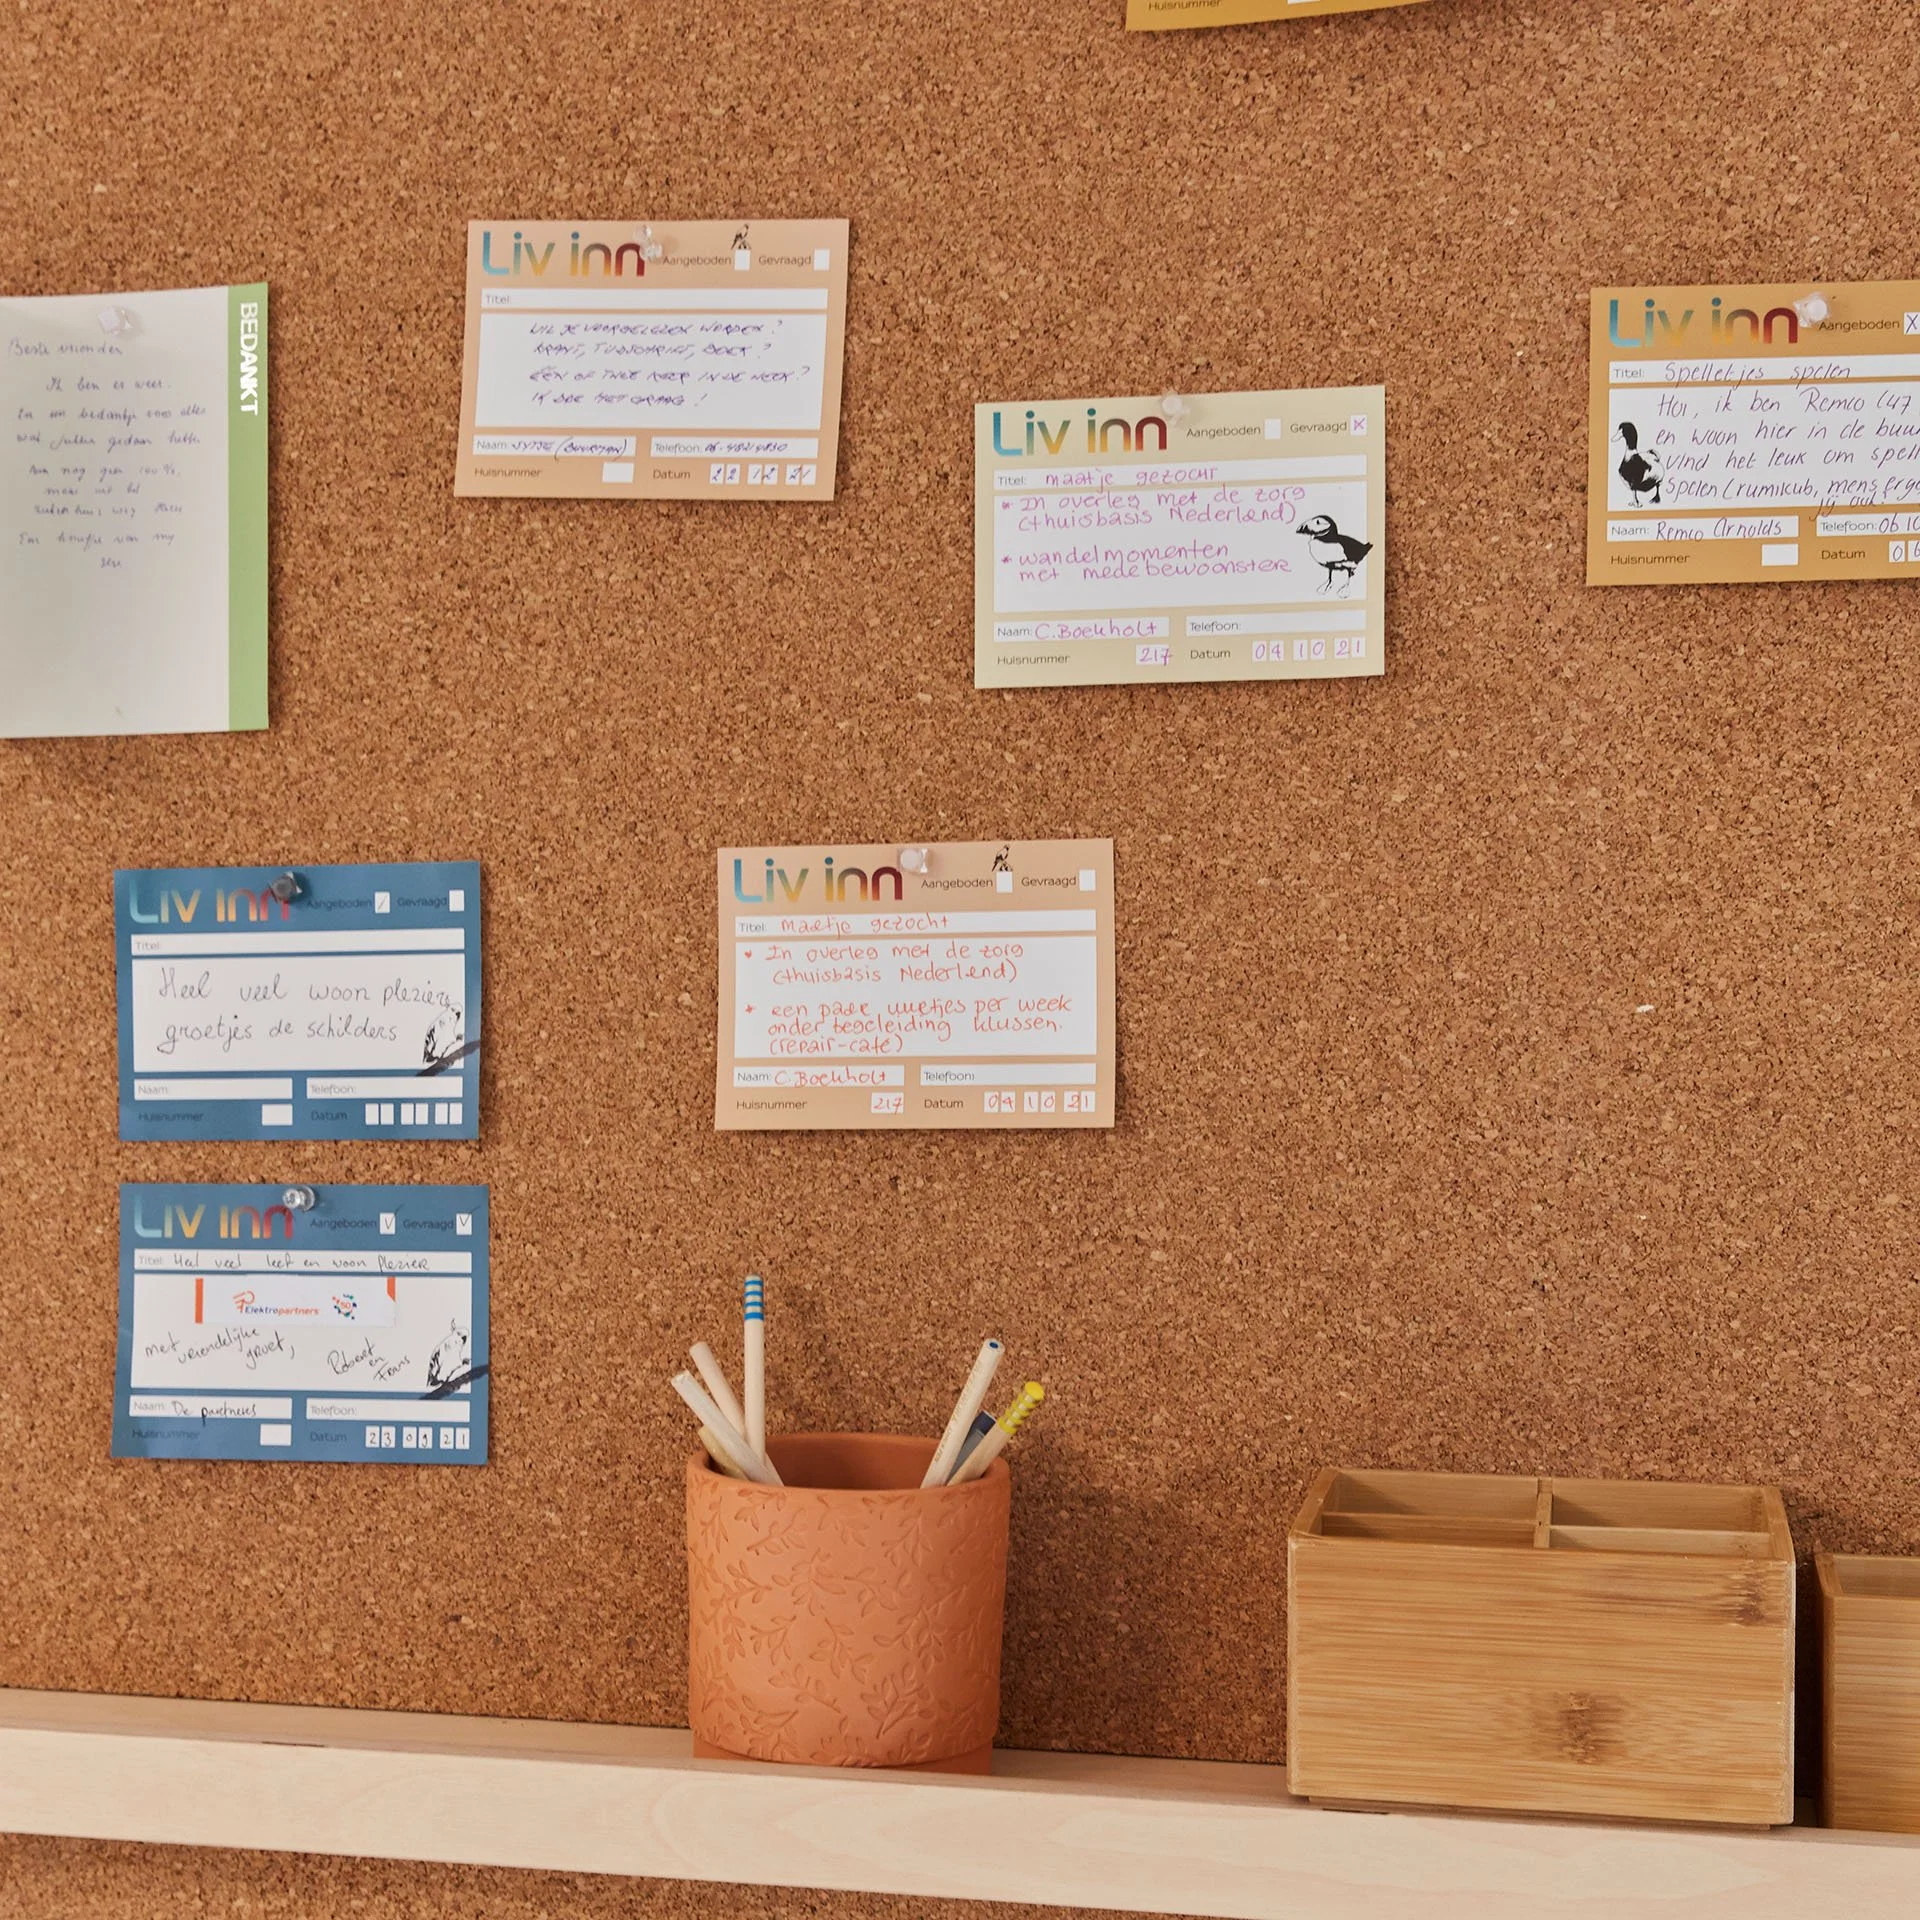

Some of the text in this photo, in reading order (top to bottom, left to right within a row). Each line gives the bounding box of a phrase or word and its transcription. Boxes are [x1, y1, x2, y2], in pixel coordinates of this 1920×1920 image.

[483, 231, 645, 277] Liv inn
[758, 254, 812, 268] Gevraagd
[663, 255, 732, 268] Aangeboden
[1608, 297, 1799, 347] Liv inn
[1818, 319, 1901, 332] Aangeboden
[240, 301, 258, 416] BEDANKT
[1613, 367, 1645, 379] Titel:
[1714, 389, 1733, 413] ik
[1750, 389, 1781, 413] ben
[993, 408, 1168, 456] Liv inn
[1186, 424, 1262, 439] Aangeboden
[1290, 421, 1348, 434] Gevraagd
[1755, 419, 1797, 440] hier
[1807, 421, 1827, 440] in
[1839, 418, 1865, 439] de
[1725, 449, 1757, 470] het
[474, 467, 543, 478] Huisnummer
[652, 468, 691, 480] Datum
[1213, 481, 1242, 504] de
[1611, 524, 1650, 537] Naam:
[1609, 552, 1691, 566] Huisnummer
[1820, 549, 1867, 561] Datum
[997, 645, 1174, 667] Huisnummer 217
[1190, 648, 1231, 660] Datum
[733, 856, 903, 903] Liv inn
[920, 877, 994, 890] Aangeboden
[1021, 876, 1077, 888] Gevraagd
[945, 940, 971, 960] de
[239, 973, 289, 1002] veel
[308, 986, 372, 1001] woon
[1017, 993, 1073, 1013] week
[268, 1018, 294, 1039] de
[736, 1097, 904, 1116] Huisnummer 217
[923, 1098, 964, 1110] Datum
[310, 1110, 348, 1121] Datum
[309, 1218, 378, 1230] Aangeboden
[402, 1219, 455, 1231] Gevraagd
[245, 1305, 320, 1317] Elektropartners
[309, 1431, 348, 1443] Datum
